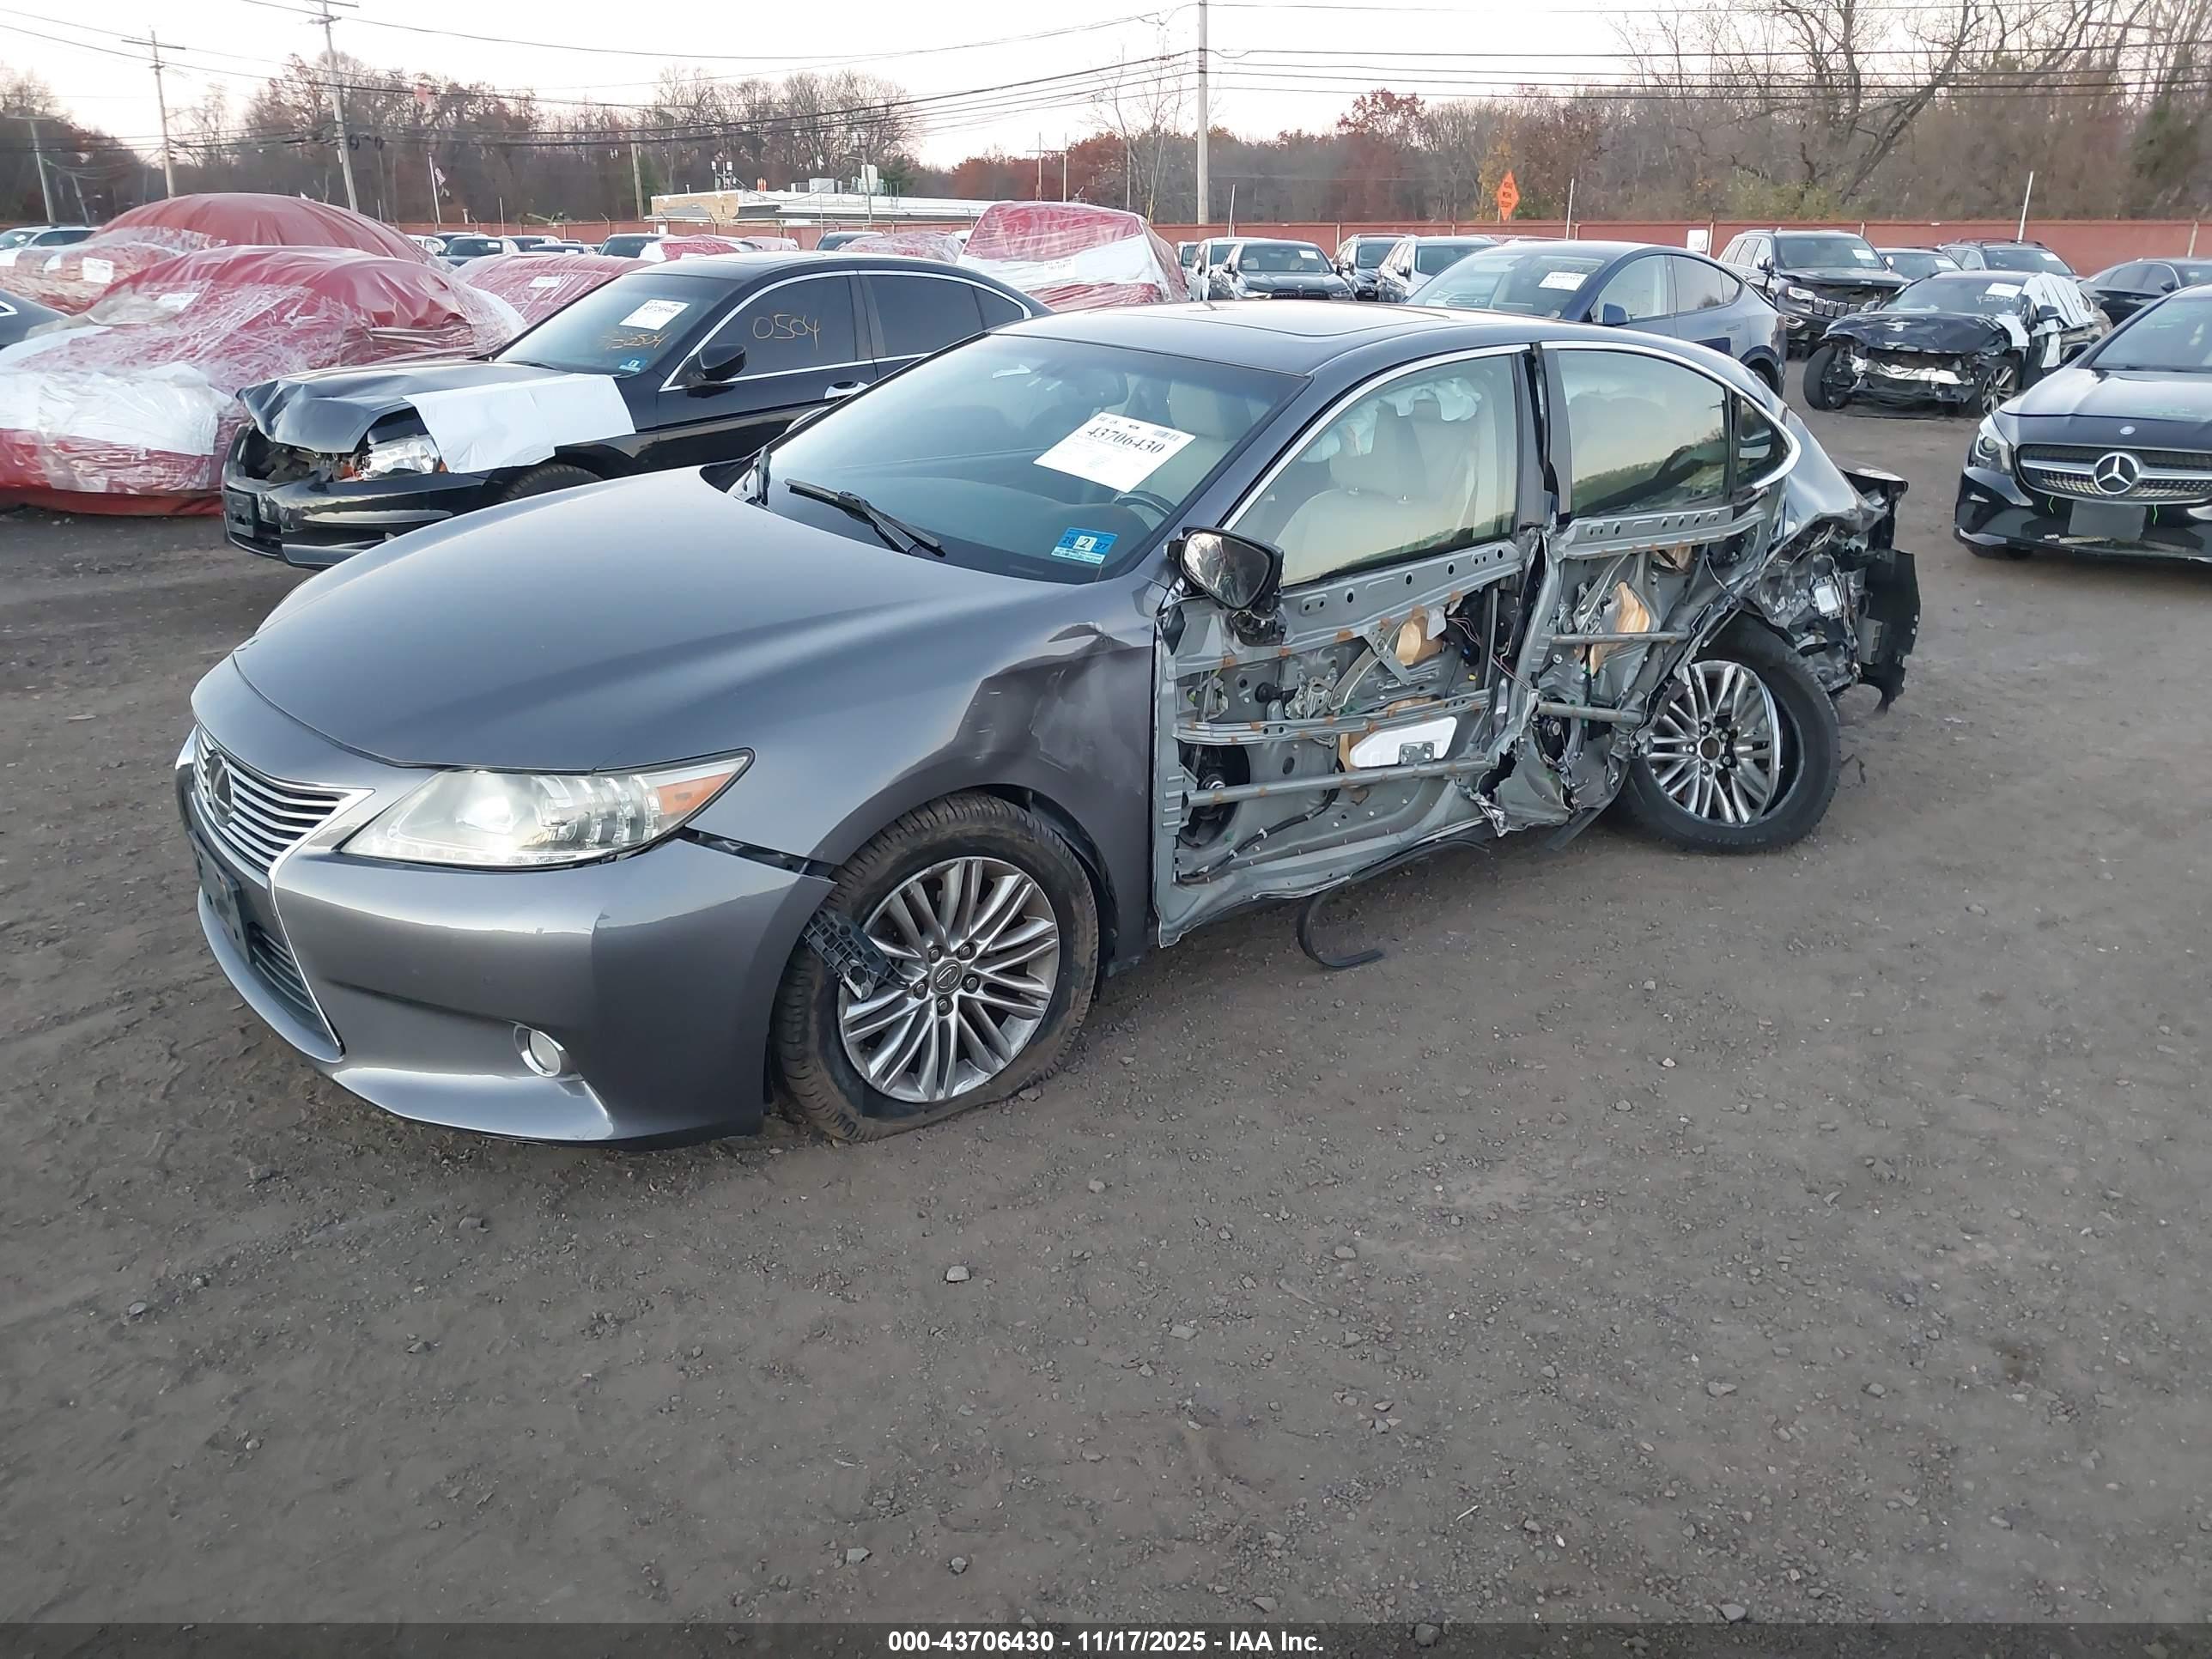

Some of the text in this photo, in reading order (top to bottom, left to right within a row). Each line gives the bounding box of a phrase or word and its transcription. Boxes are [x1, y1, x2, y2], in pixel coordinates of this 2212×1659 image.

[752, 313, 820, 350] 0504
[1086, 426, 1166, 454] 43706430
[1062, 536, 1109, 550] 20 2 27
